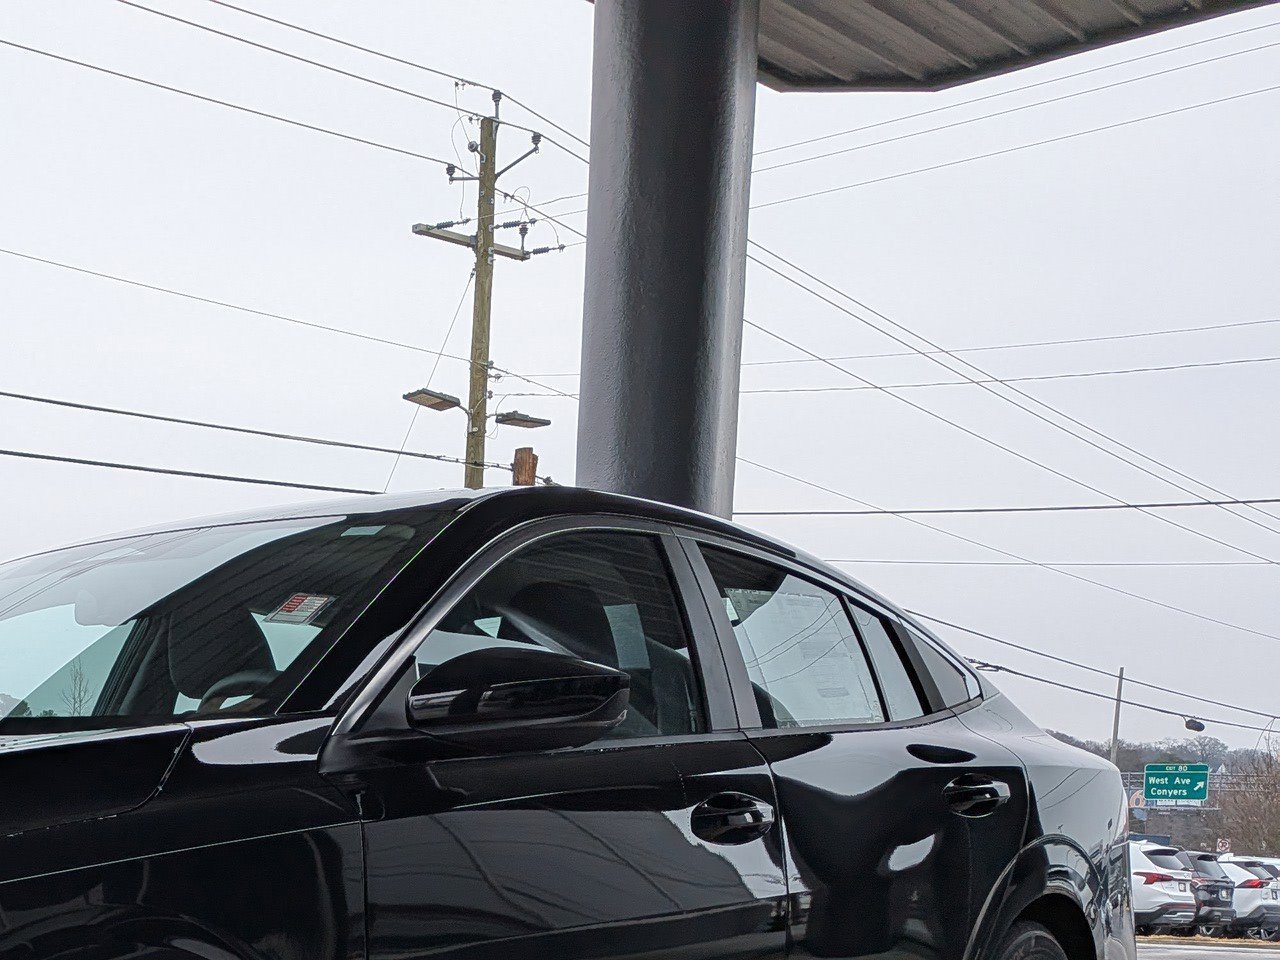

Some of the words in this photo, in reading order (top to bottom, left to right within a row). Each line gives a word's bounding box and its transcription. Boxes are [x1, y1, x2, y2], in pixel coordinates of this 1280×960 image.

[1148, 777, 1168, 785] West
[1174, 776, 1191, 785] Ave
[1150, 788, 1187, 797] Conyers
